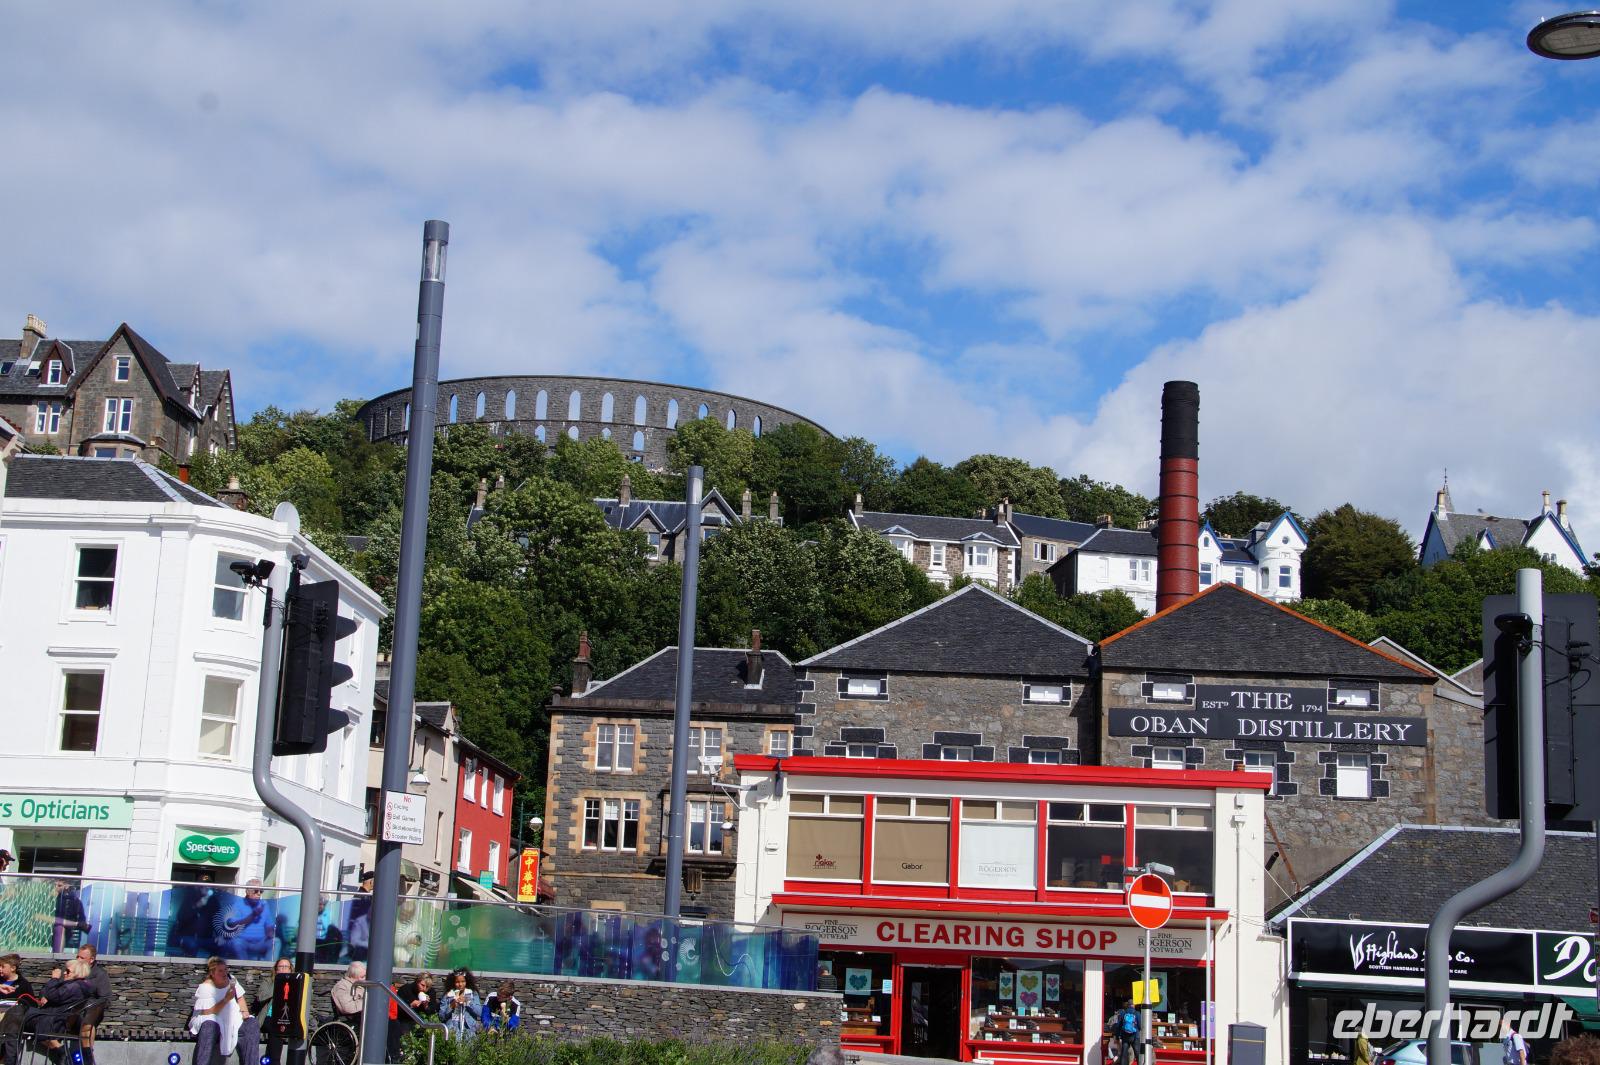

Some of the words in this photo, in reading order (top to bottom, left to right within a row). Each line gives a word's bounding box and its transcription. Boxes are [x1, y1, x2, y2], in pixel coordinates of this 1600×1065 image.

[1231, 691, 1293, 711] THE
[1301, 704, 1323, 713] 1794
[1130, 716, 1209, 735] OBAN
[1238, 718, 1413, 742] DISTILLERY
[403, 795, 412, 803] No
[20, 798, 110, 823] Opticians
[186, 841, 235, 854] Specsavers
[901, 862, 923, 870] Gabor
[978, 865, 1017, 873] ROGERSON
[877, 921, 1025, 948] CLEARING
[1036, 928, 1118, 951] SHOP
[1157, 932, 1173, 940] FINE
[1138, 938, 1193, 949] RGERSON
[1366, 930, 1418, 966] Highland
[1150, 946, 1184, 954] OOTWEAR
